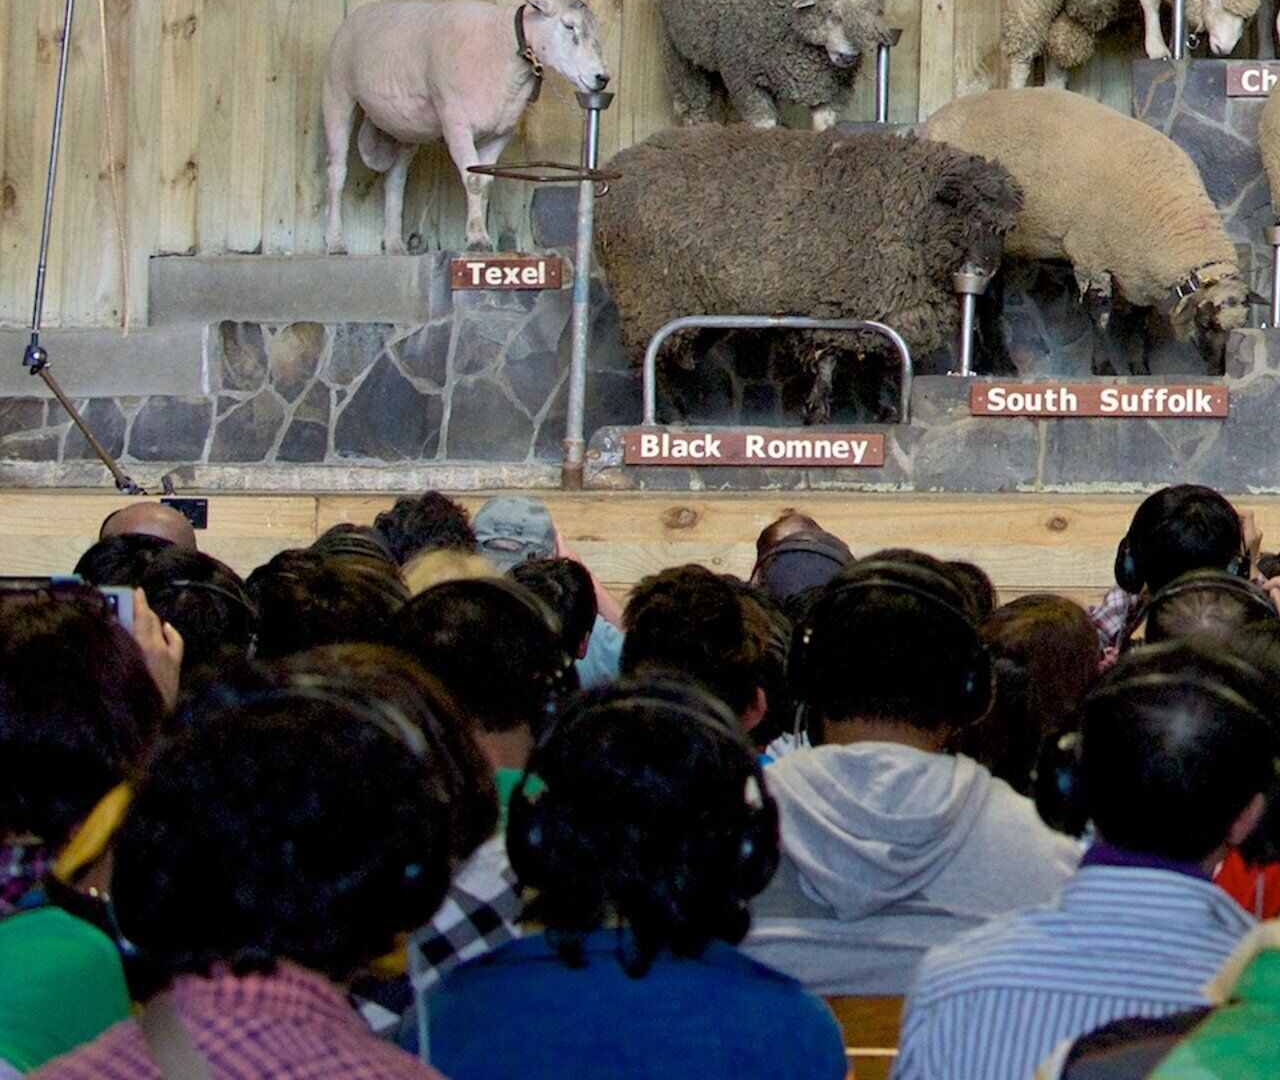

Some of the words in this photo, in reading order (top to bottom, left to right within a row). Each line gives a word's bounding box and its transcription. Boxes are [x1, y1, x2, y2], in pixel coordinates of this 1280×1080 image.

[466, 261, 546, 286] Texel
[987, 387, 1078, 412] South
[1099, 387, 1213, 413] Suffolk
[640, 433, 722, 459] Black
[745, 434, 868, 465] Romney
